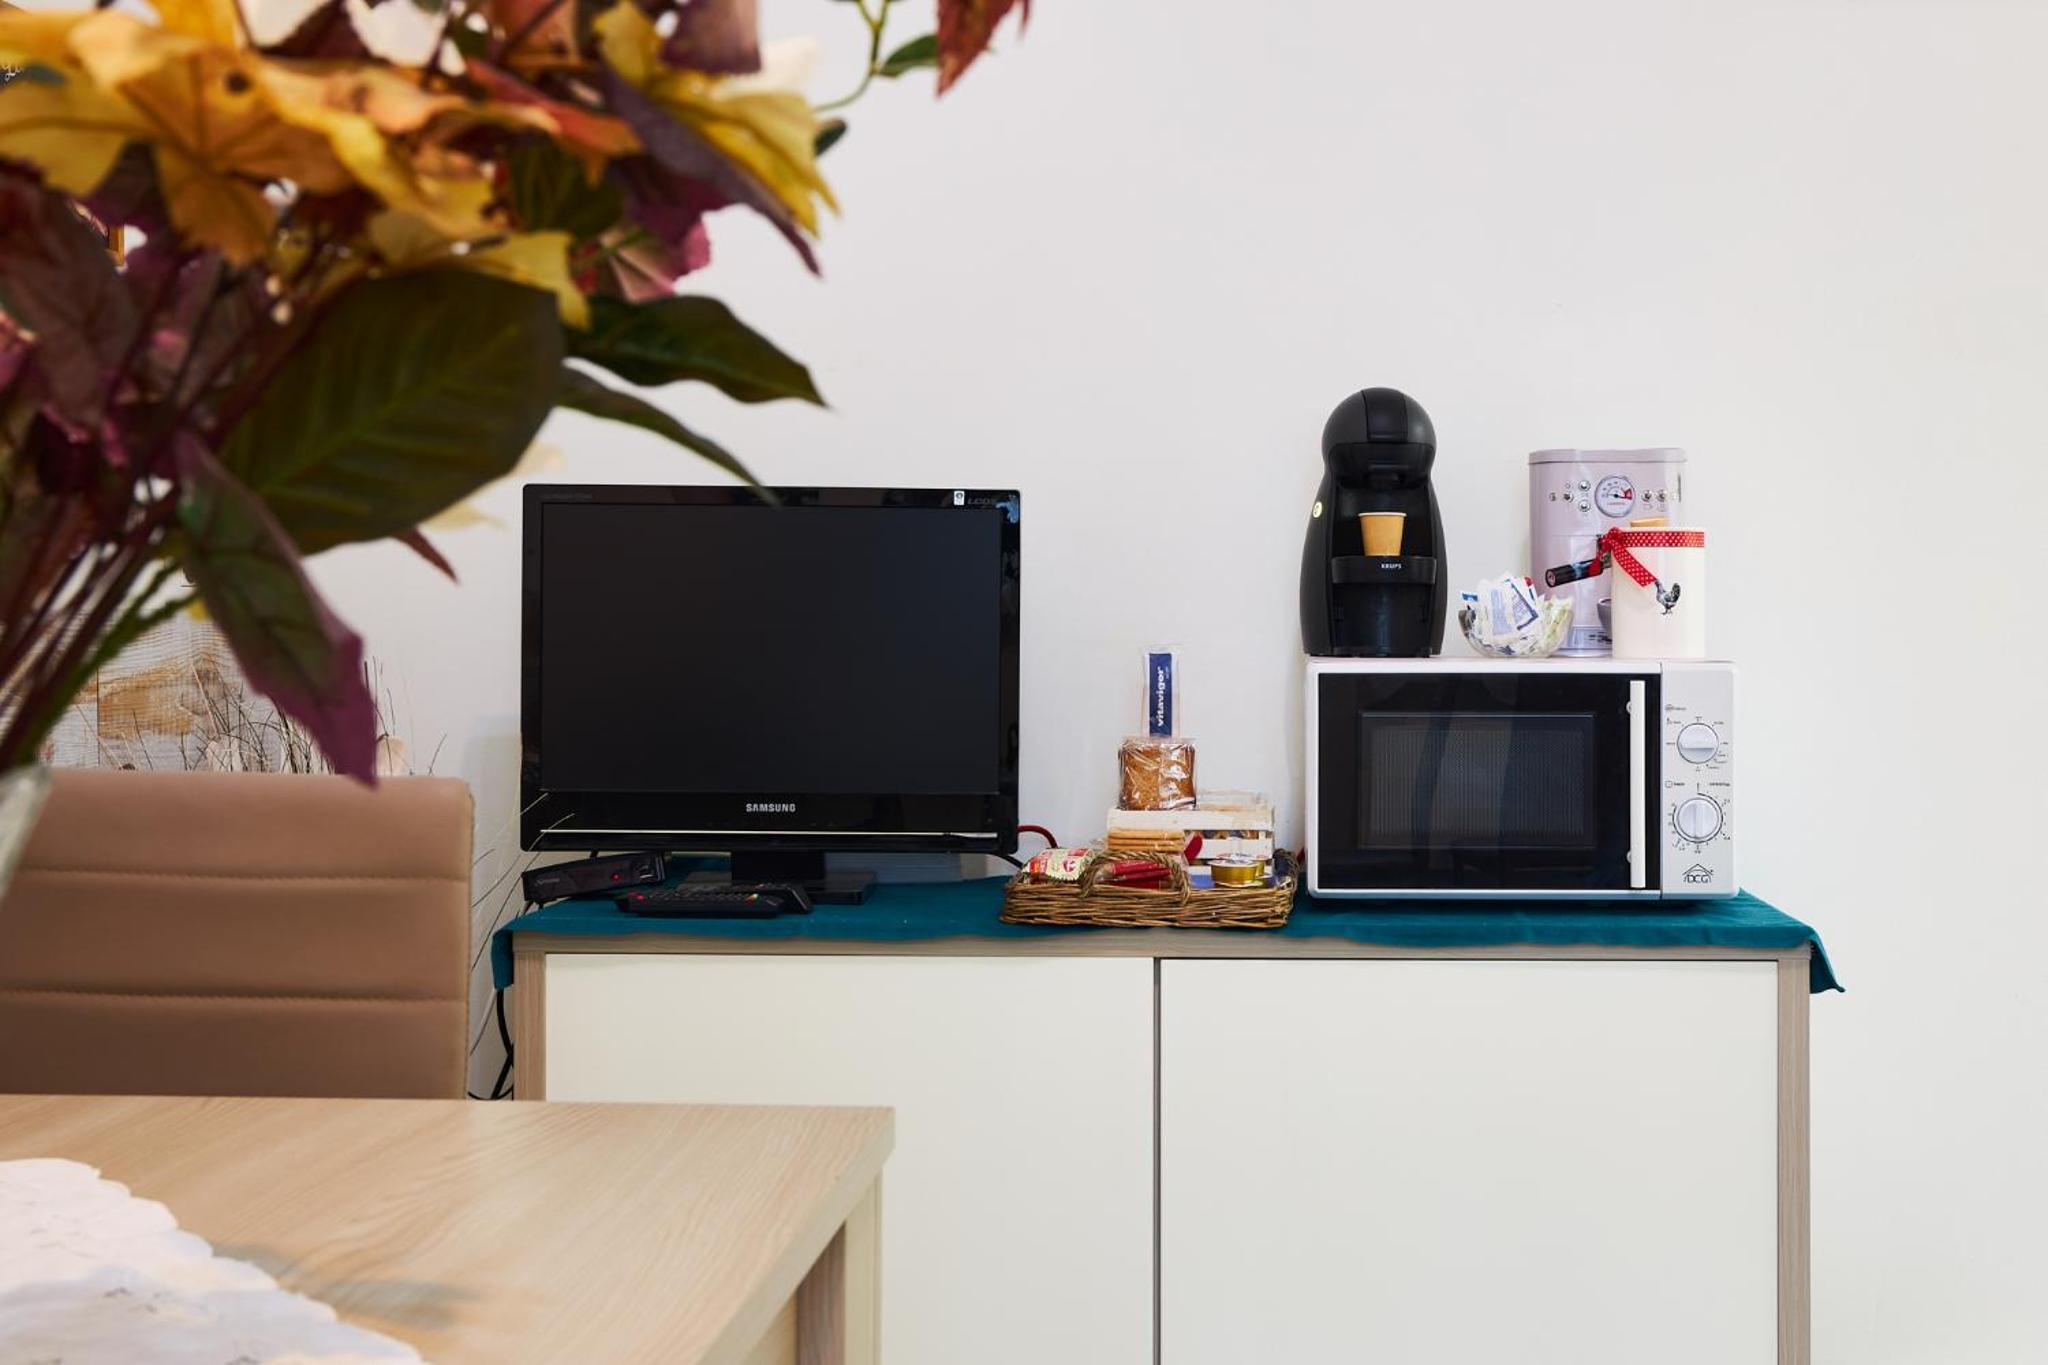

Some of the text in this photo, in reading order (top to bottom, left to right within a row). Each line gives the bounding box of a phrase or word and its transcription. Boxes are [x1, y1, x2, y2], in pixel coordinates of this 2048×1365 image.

[1156, 666, 1166, 727] vitavigor
[745, 802, 797, 813] SAMSUNG
[1685, 874, 1710, 884] DCG
